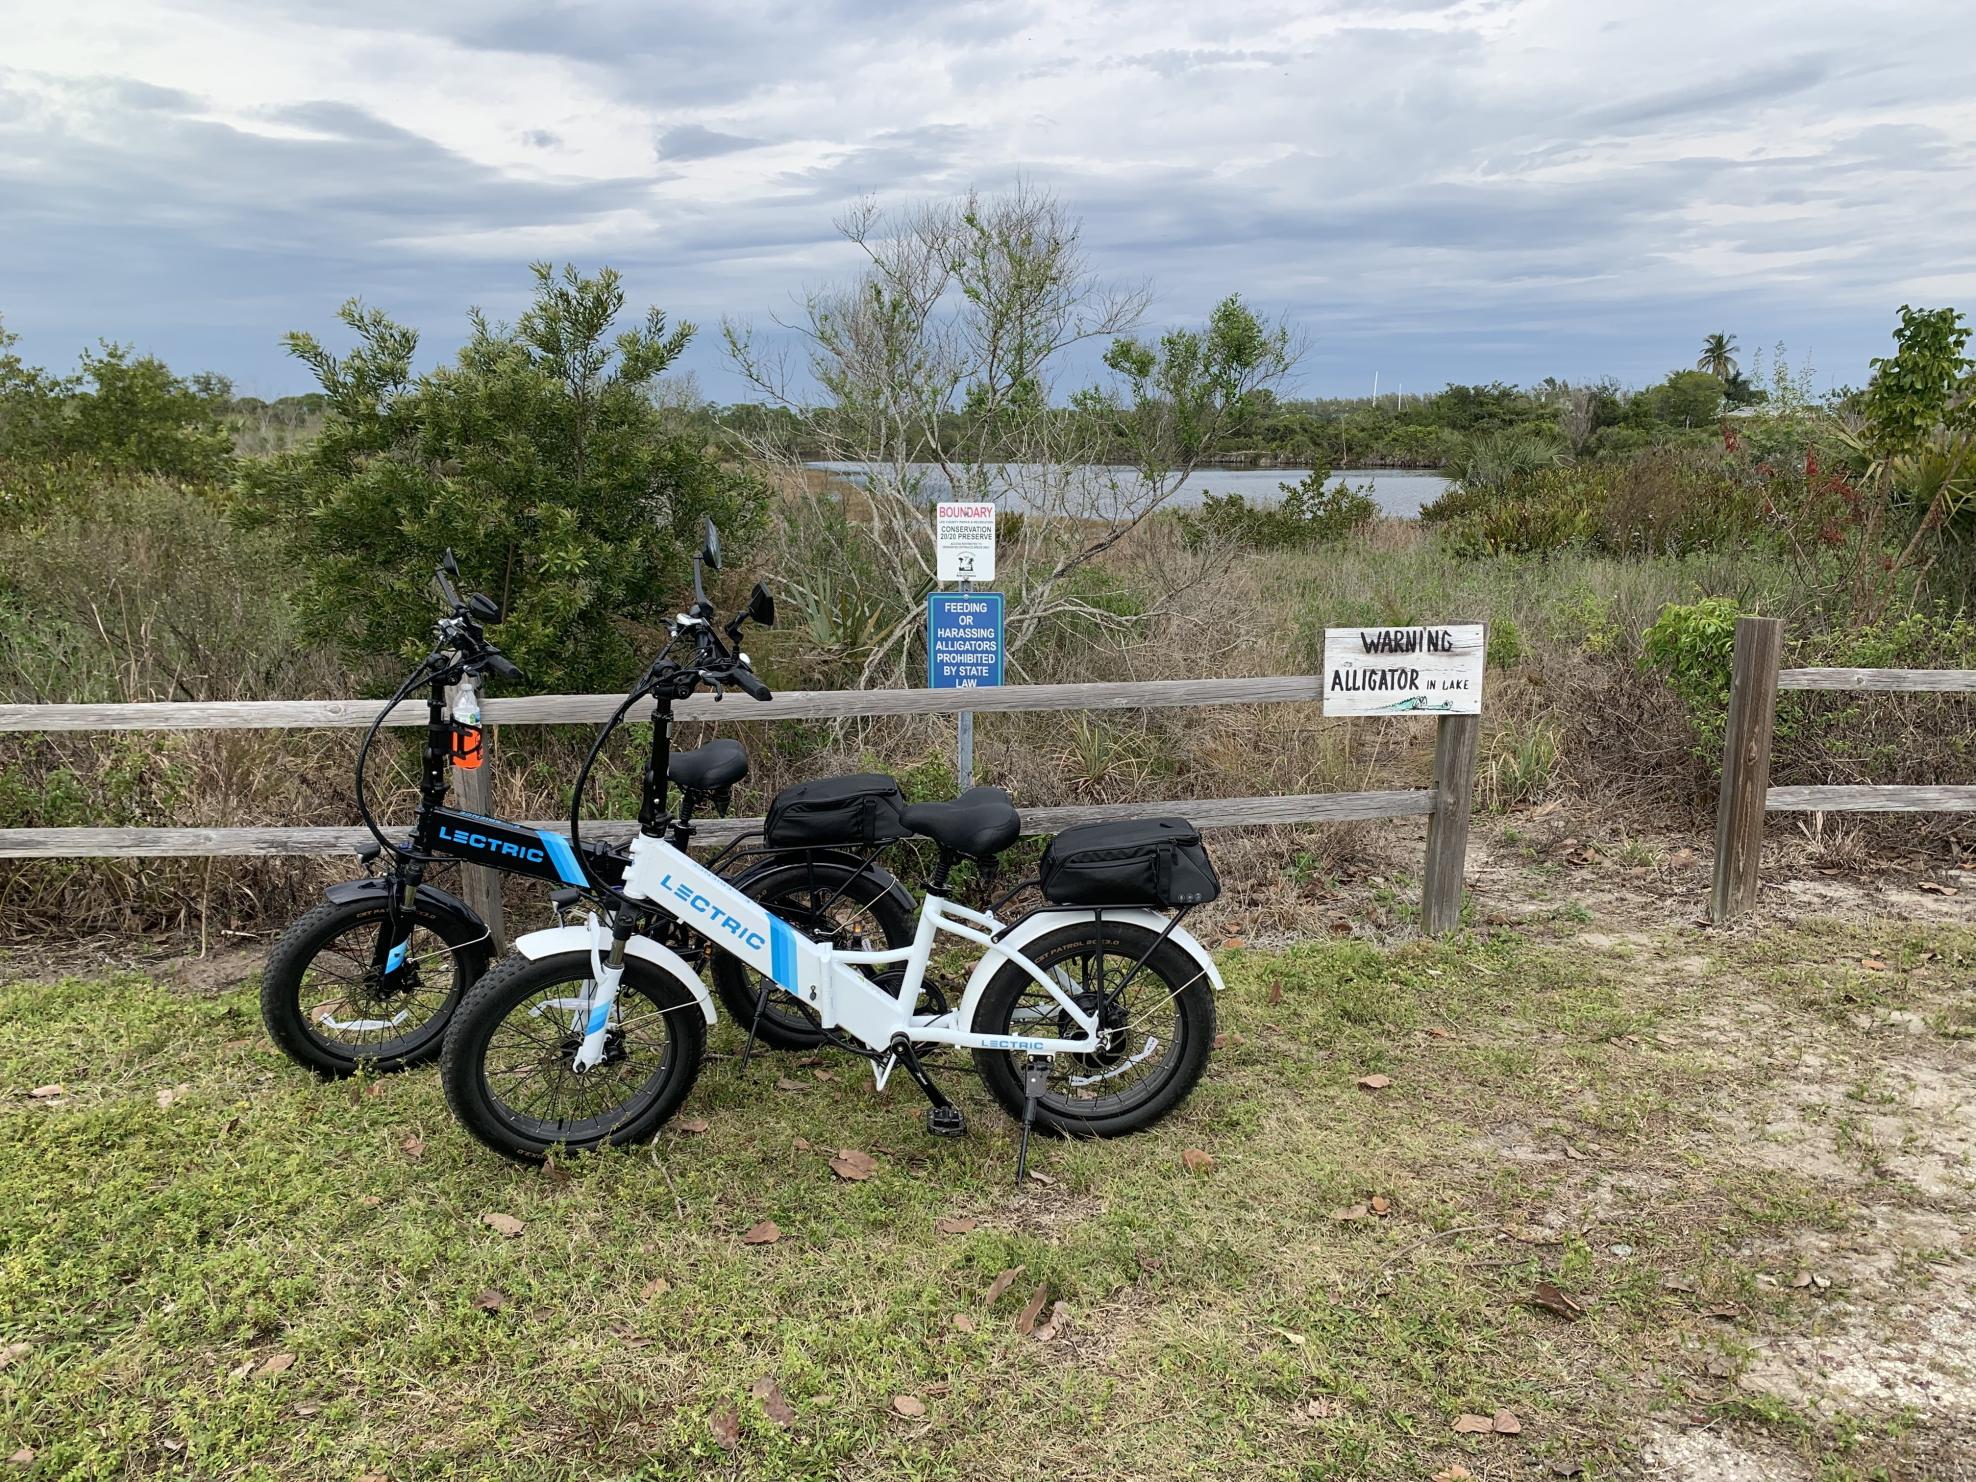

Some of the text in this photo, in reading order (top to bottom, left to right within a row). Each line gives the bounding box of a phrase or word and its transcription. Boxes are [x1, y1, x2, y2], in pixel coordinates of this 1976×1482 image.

[939, 506, 992, 518] BOUNDARY
[944, 602, 988, 613] FEEDING
[958, 615, 974, 626] OR
[937, 628, 995, 638] HARASSING
[935, 640, 997, 651] ALLIGATORS
[1360, 630, 1454, 654] WARNING
[937, 653, 996, 664] PROHIBITED
[943, 666, 989, 677] BY STATE
[955, 679, 977, 688] LAW
[1331, 668, 1470, 692] ALLIGATOR IN LAKE
[439, 826, 544, 863] LECTRIC
[660, 874, 766, 951] LECTRIC
[981, 1040, 1044, 1050] LECTRIC
